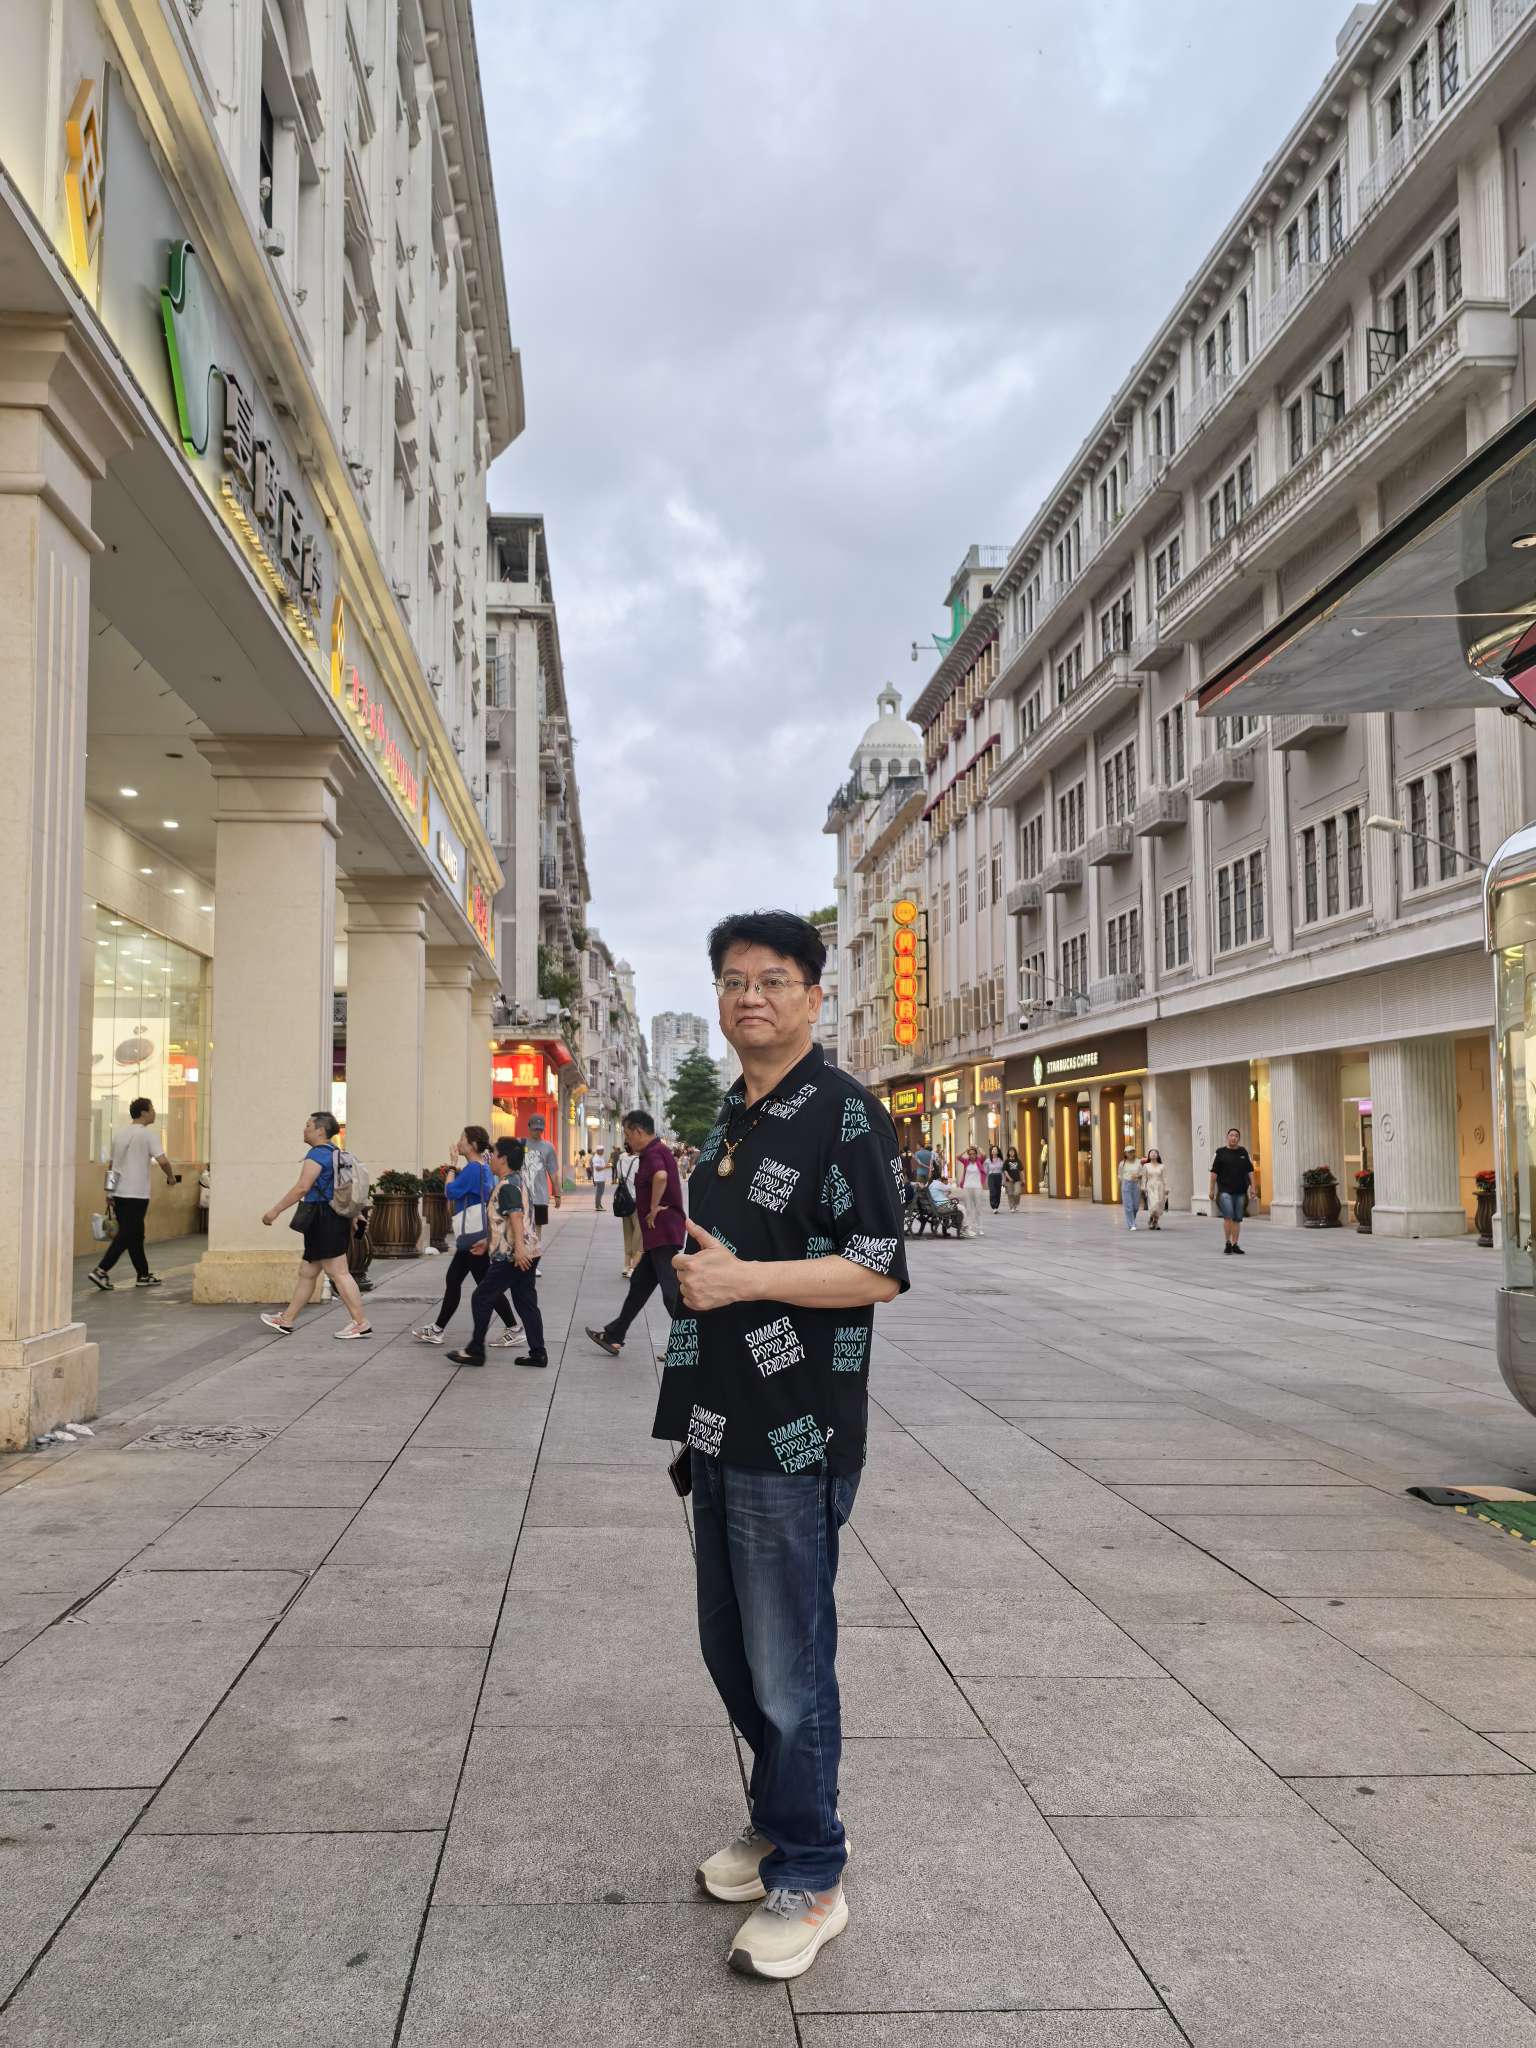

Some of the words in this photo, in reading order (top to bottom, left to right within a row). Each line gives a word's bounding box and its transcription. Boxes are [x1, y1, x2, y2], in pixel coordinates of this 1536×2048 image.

[1046, 1056, 1077, 1075] STARBUCKS
[1076, 1051, 1099, 1070] COFFEE
[752, 1170, 794, 1200] POPULAR
[759, 1157, 801, 1186] SUMMER
[747, 1185, 789, 1214] TENDENCY
[852, 1234, 898, 1253] SUMMER
[745, 1315, 793, 1349] SUMMER
[751, 1330, 801, 1364] POPULAR
[757, 1344, 806, 1379] TENDENCY
[688, 1418, 723, 1448] POPULAR
[691, 1404, 727, 1432] SUMMER
[767, 1414, 818, 1446] SUMMER
[774, 1428, 825, 1461] POPULAR
